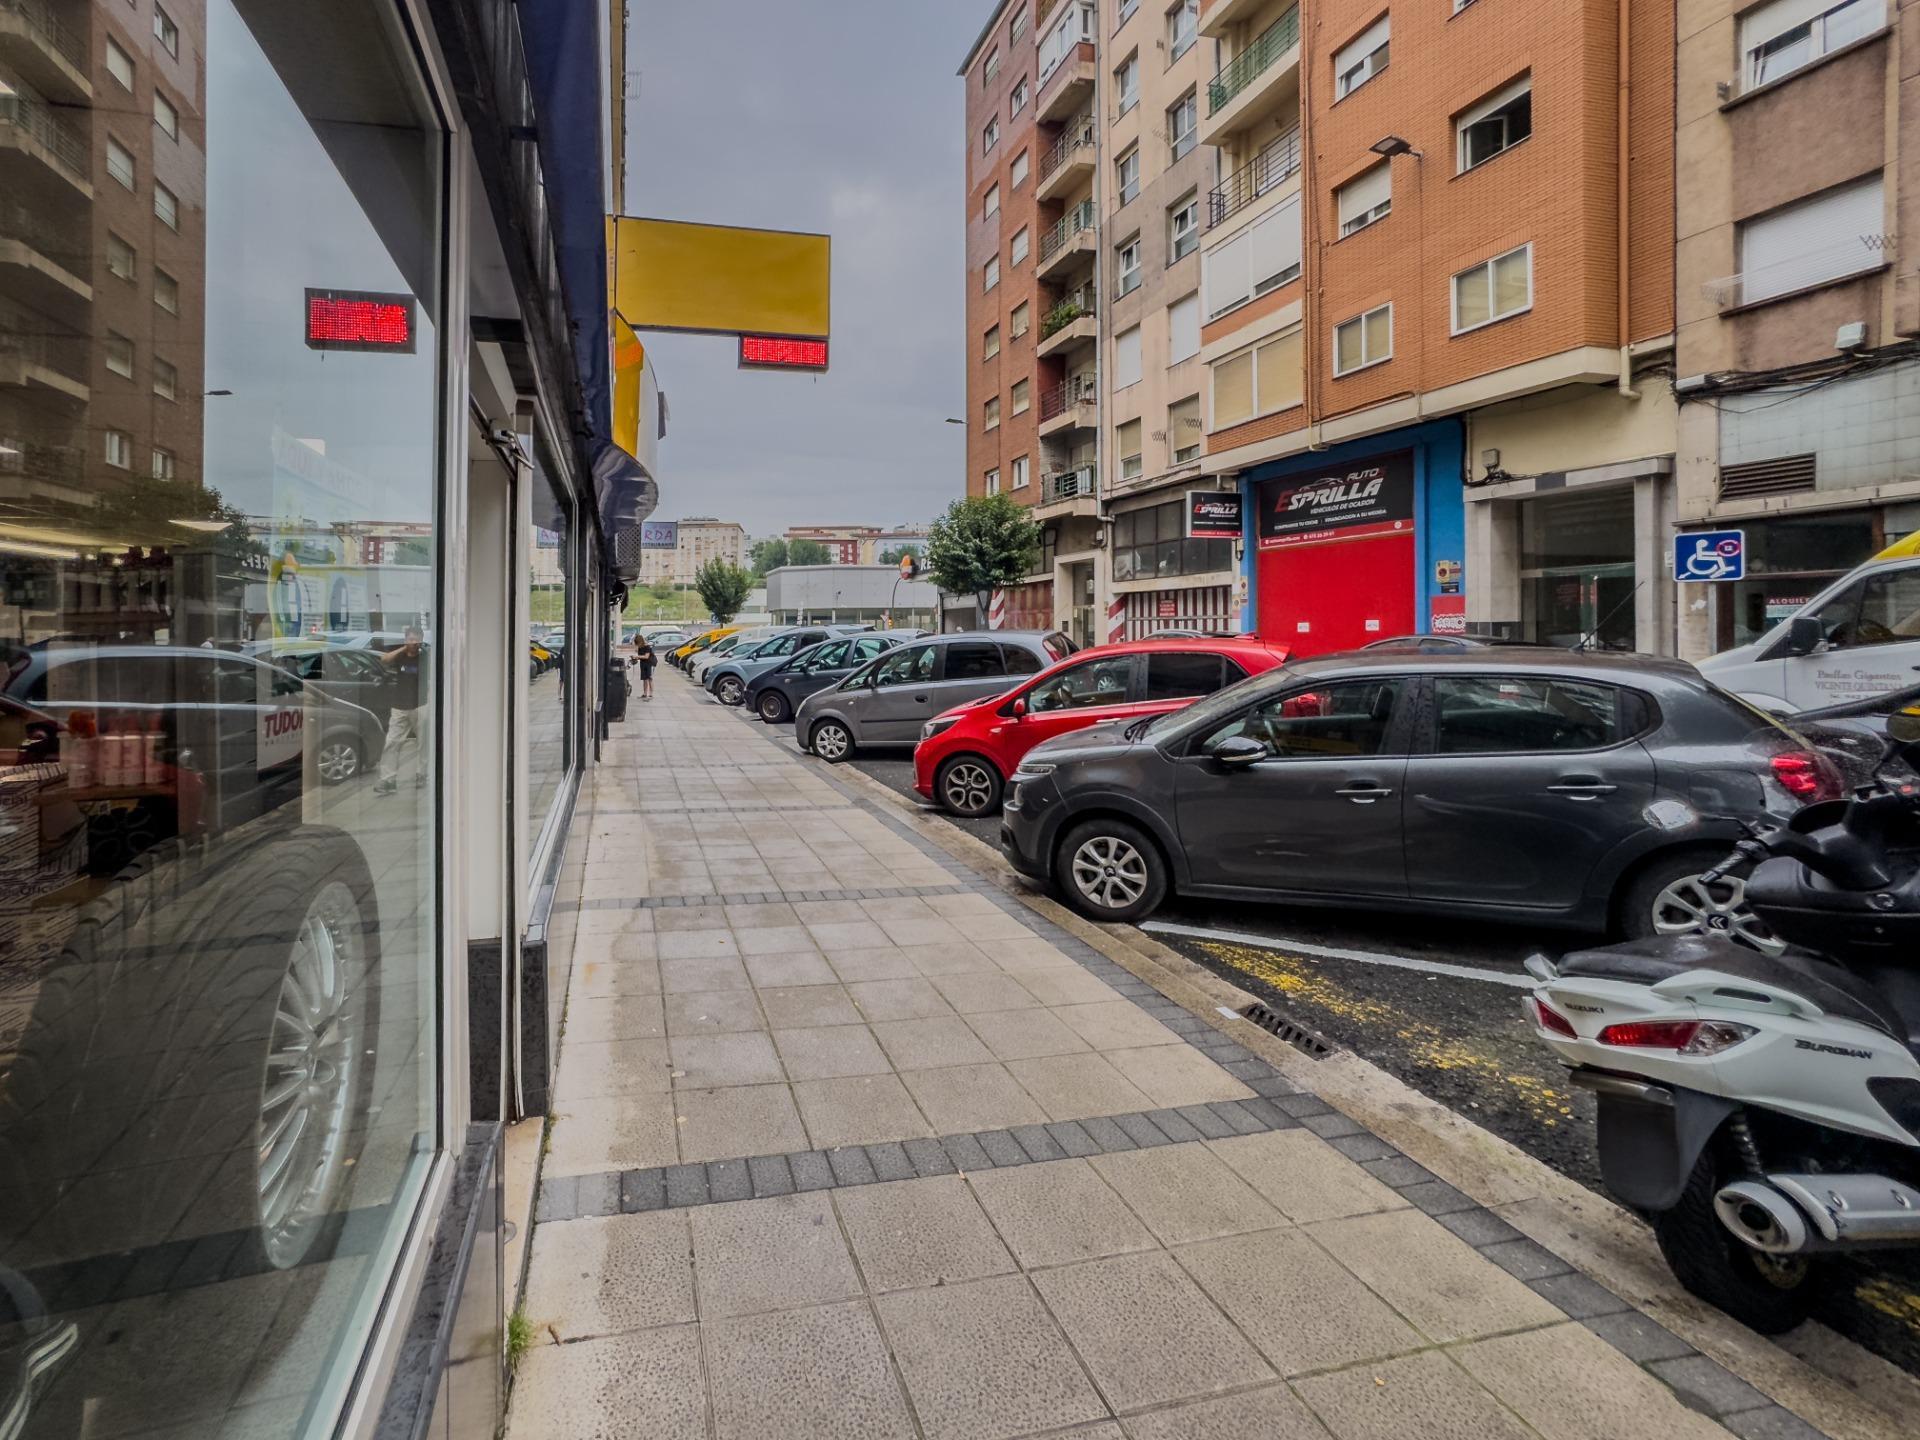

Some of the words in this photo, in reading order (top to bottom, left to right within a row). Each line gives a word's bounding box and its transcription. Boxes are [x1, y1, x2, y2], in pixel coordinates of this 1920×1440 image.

[1347, 467, 1380, 482] AUTO
[1275, 477, 1384, 513] ESPRILLA
[1194, 504, 1239, 514] ESPRILLA
[1854, 670, 1902, 682] Gigantes
[1815, 681, 1852, 690] VICENTE
[1564, 1002, 1605, 1014] SUZUKI
[1794, 1038, 1872, 1060] BURGMAN
